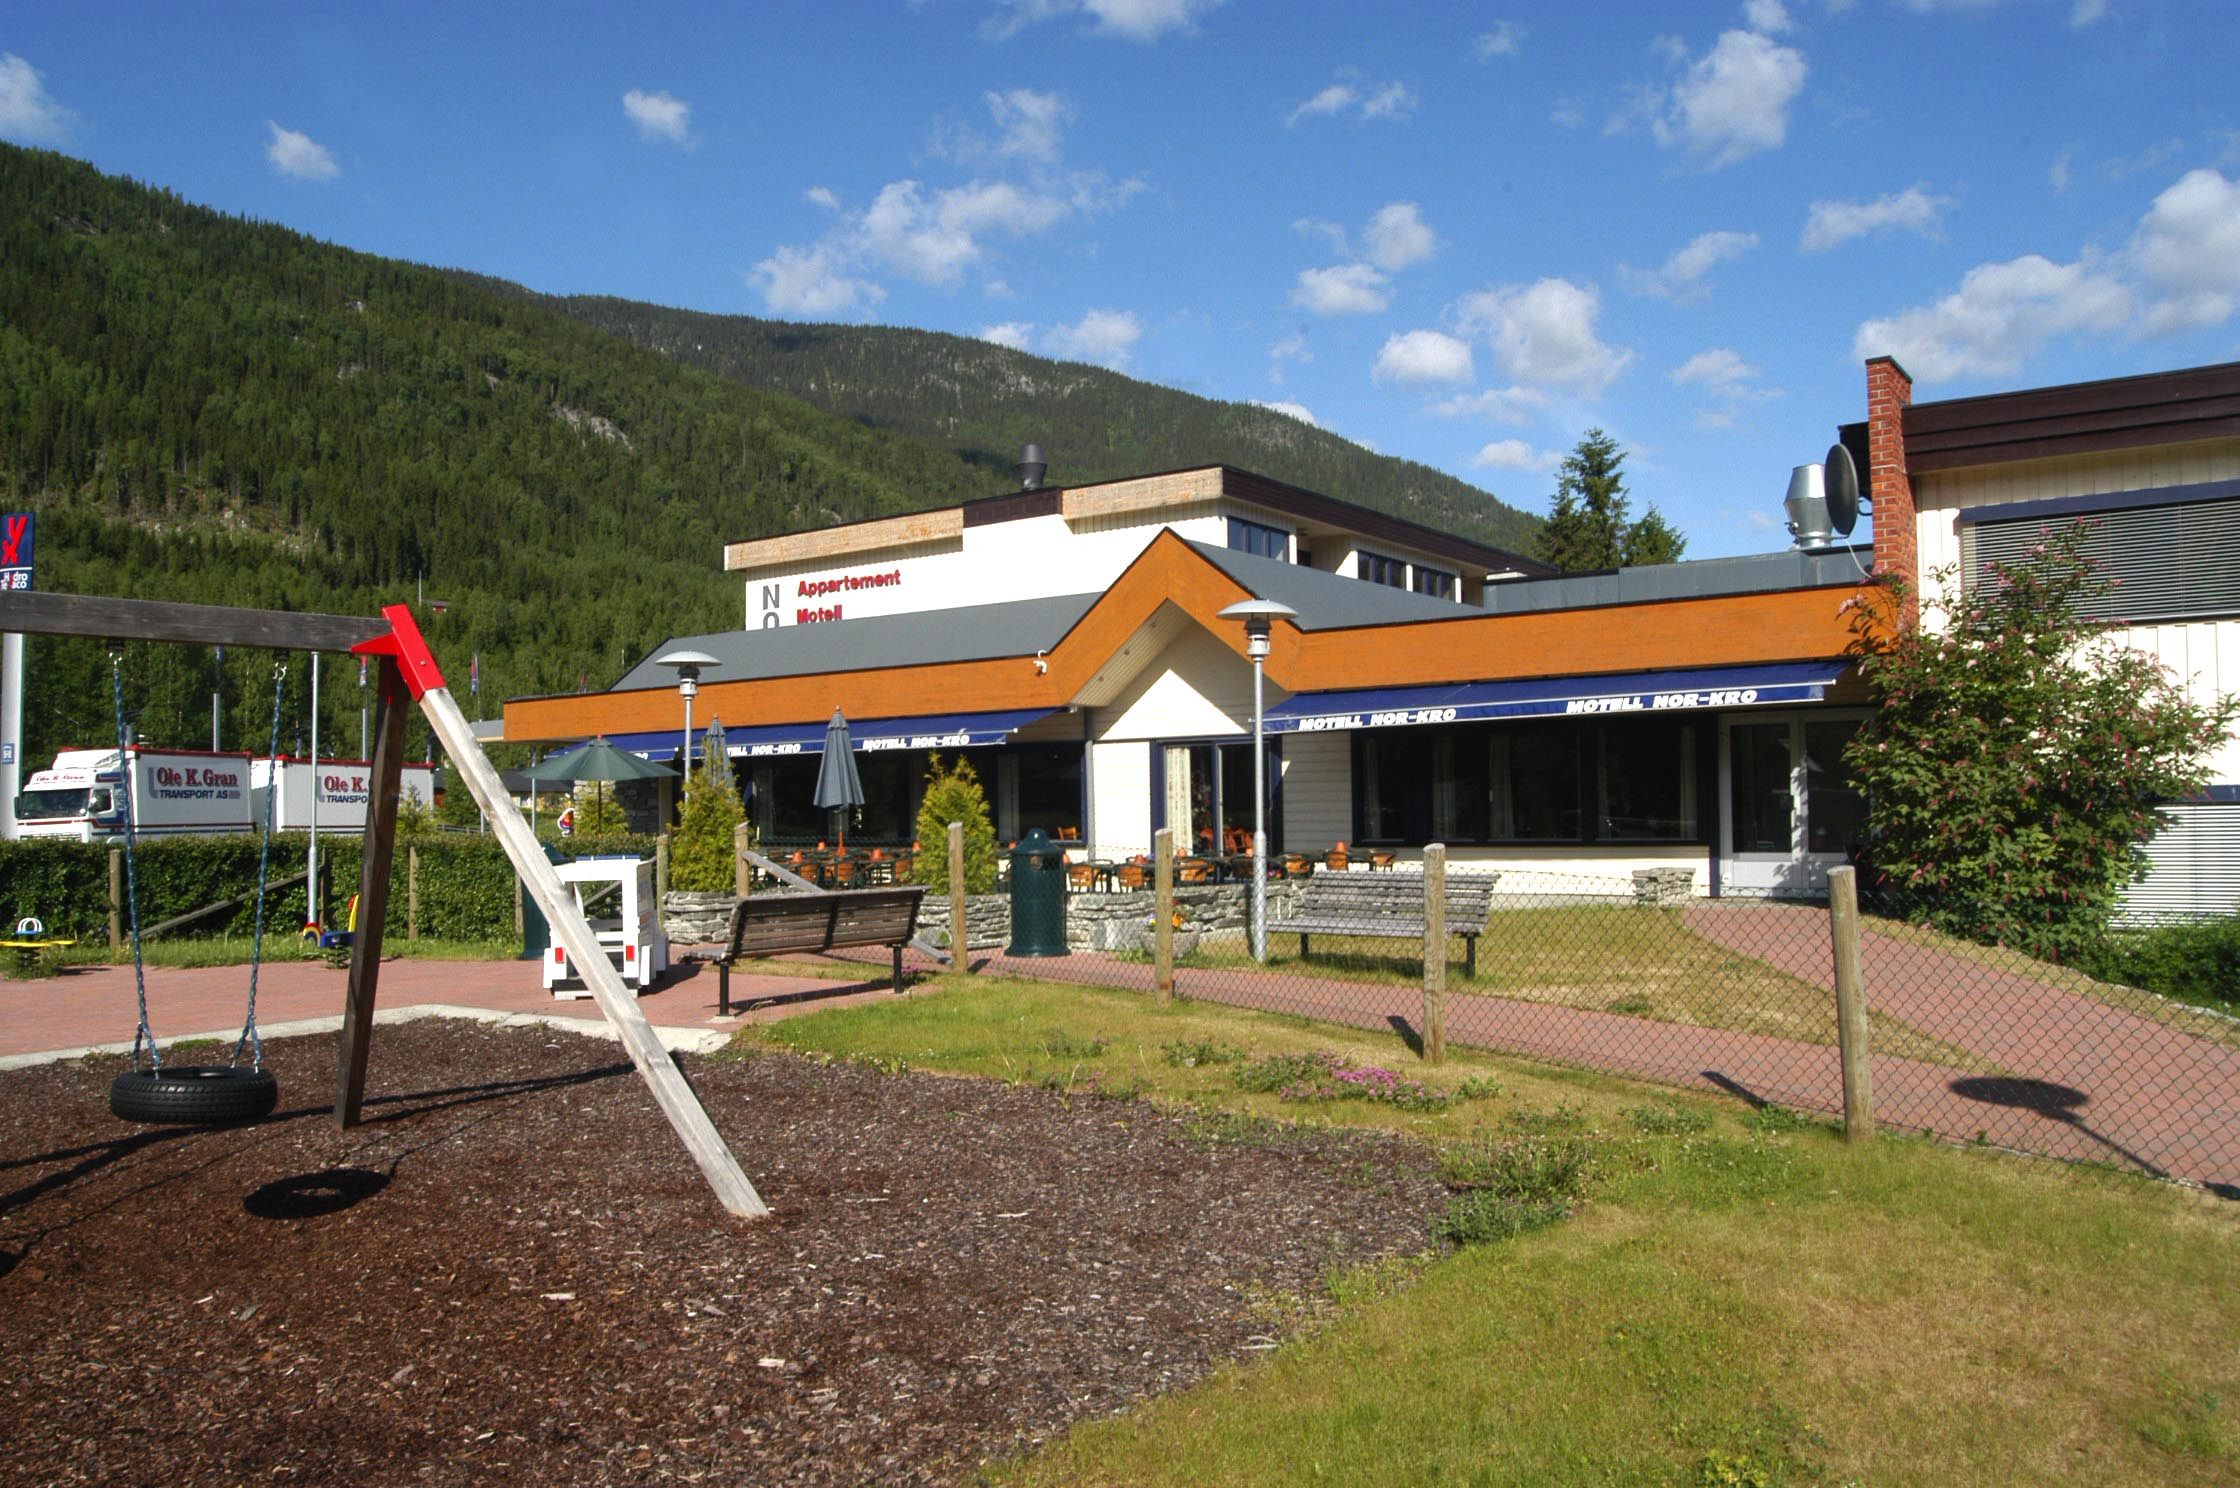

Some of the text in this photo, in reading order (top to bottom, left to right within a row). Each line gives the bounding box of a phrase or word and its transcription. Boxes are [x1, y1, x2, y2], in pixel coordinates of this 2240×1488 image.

[797, 569, 901, 598] Appartement
[796, 604, 843, 625] Motell
[1566, 689, 1757, 714] MOTELL NOR-KRO
[1299, 708, 1456, 731] MOTELL NOR-KRO
[726, 743, 801, 758] TELL NOR-KRO
[863, 738, 907, 751] MOTELL
[157, 767, 182, 786] Ole
[324, 776, 349, 793] Ole
[160, 789, 214, 799] TRANSPORT
[327, 795, 368, 804] TRANSPO
